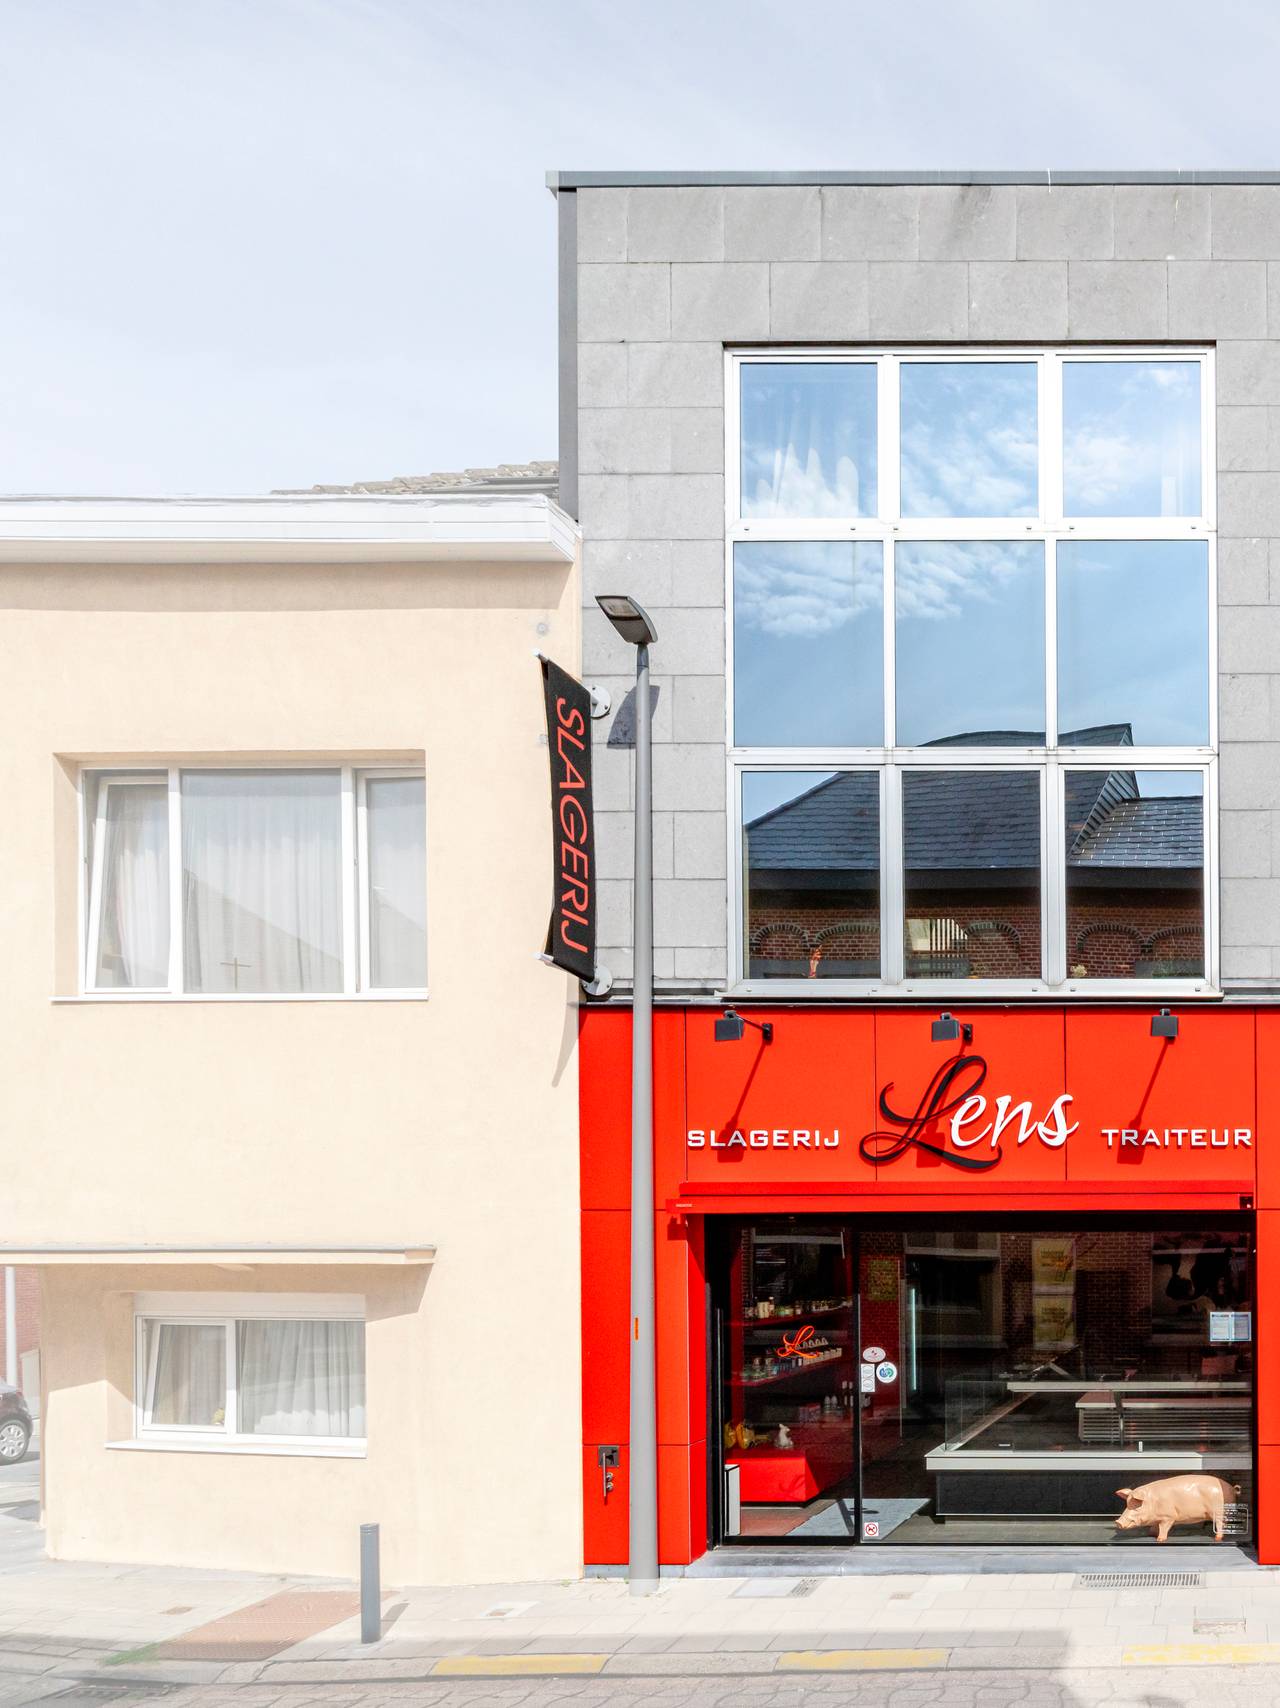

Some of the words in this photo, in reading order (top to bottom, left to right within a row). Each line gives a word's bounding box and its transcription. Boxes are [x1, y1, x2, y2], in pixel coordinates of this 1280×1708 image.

[556, 696, 588, 953] SLAGERIJ
[687, 1130, 839, 1147] SLAGERIJ
[859, 1055, 1079, 1169] Lens
[1101, 1129, 1252, 1146] TRAITEUR
